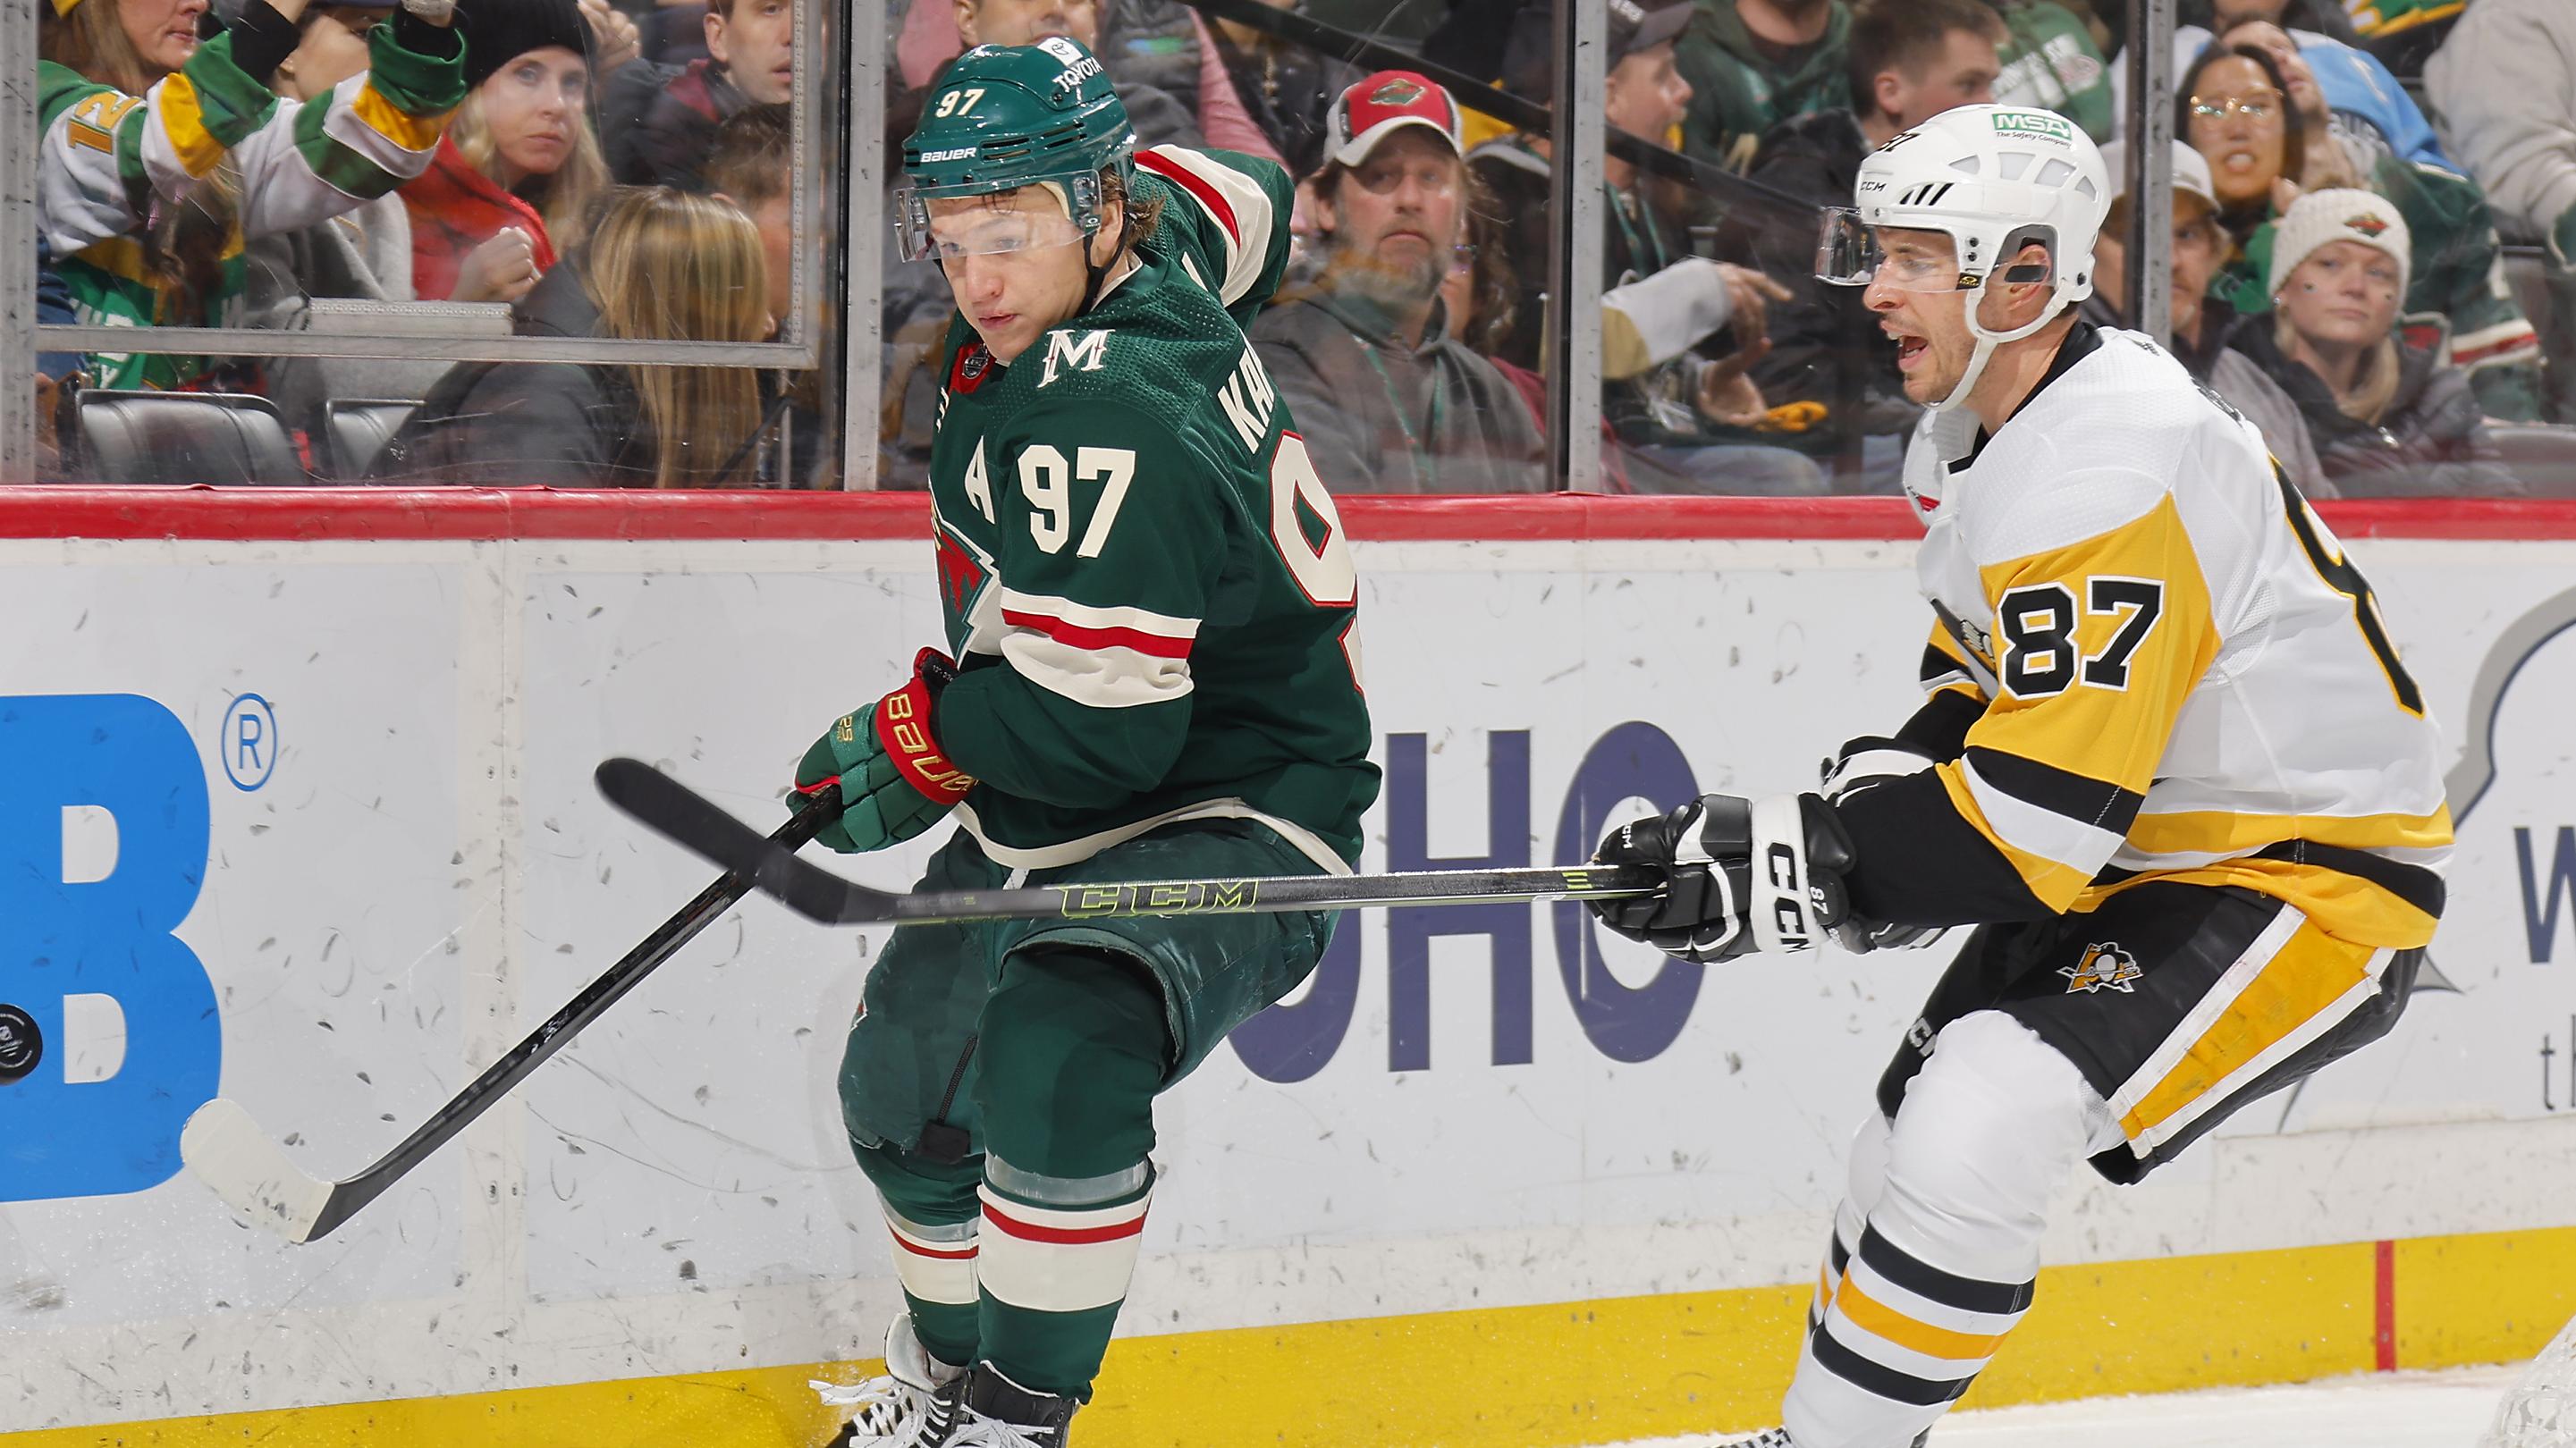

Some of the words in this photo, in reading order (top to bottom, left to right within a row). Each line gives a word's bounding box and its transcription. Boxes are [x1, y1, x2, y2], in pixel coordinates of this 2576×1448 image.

[1052, 56, 1103, 93] TOYOTA
[935, 88, 985, 118] 97
[1997, 114, 2072, 138] MSA
[2012, 132, 2037, 141] Safety
[921, 147, 977, 163] BAUER
[1860, 181, 1887, 192] CCM
[1037, 329, 1116, 389] M
[965, 434, 995, 525] A
[1018, 444, 1136, 559] 97
[1997, 575, 2166, 701] 87
[1061, 880, 1260, 920] CCM
[1810, 886, 1829, 915] 87
